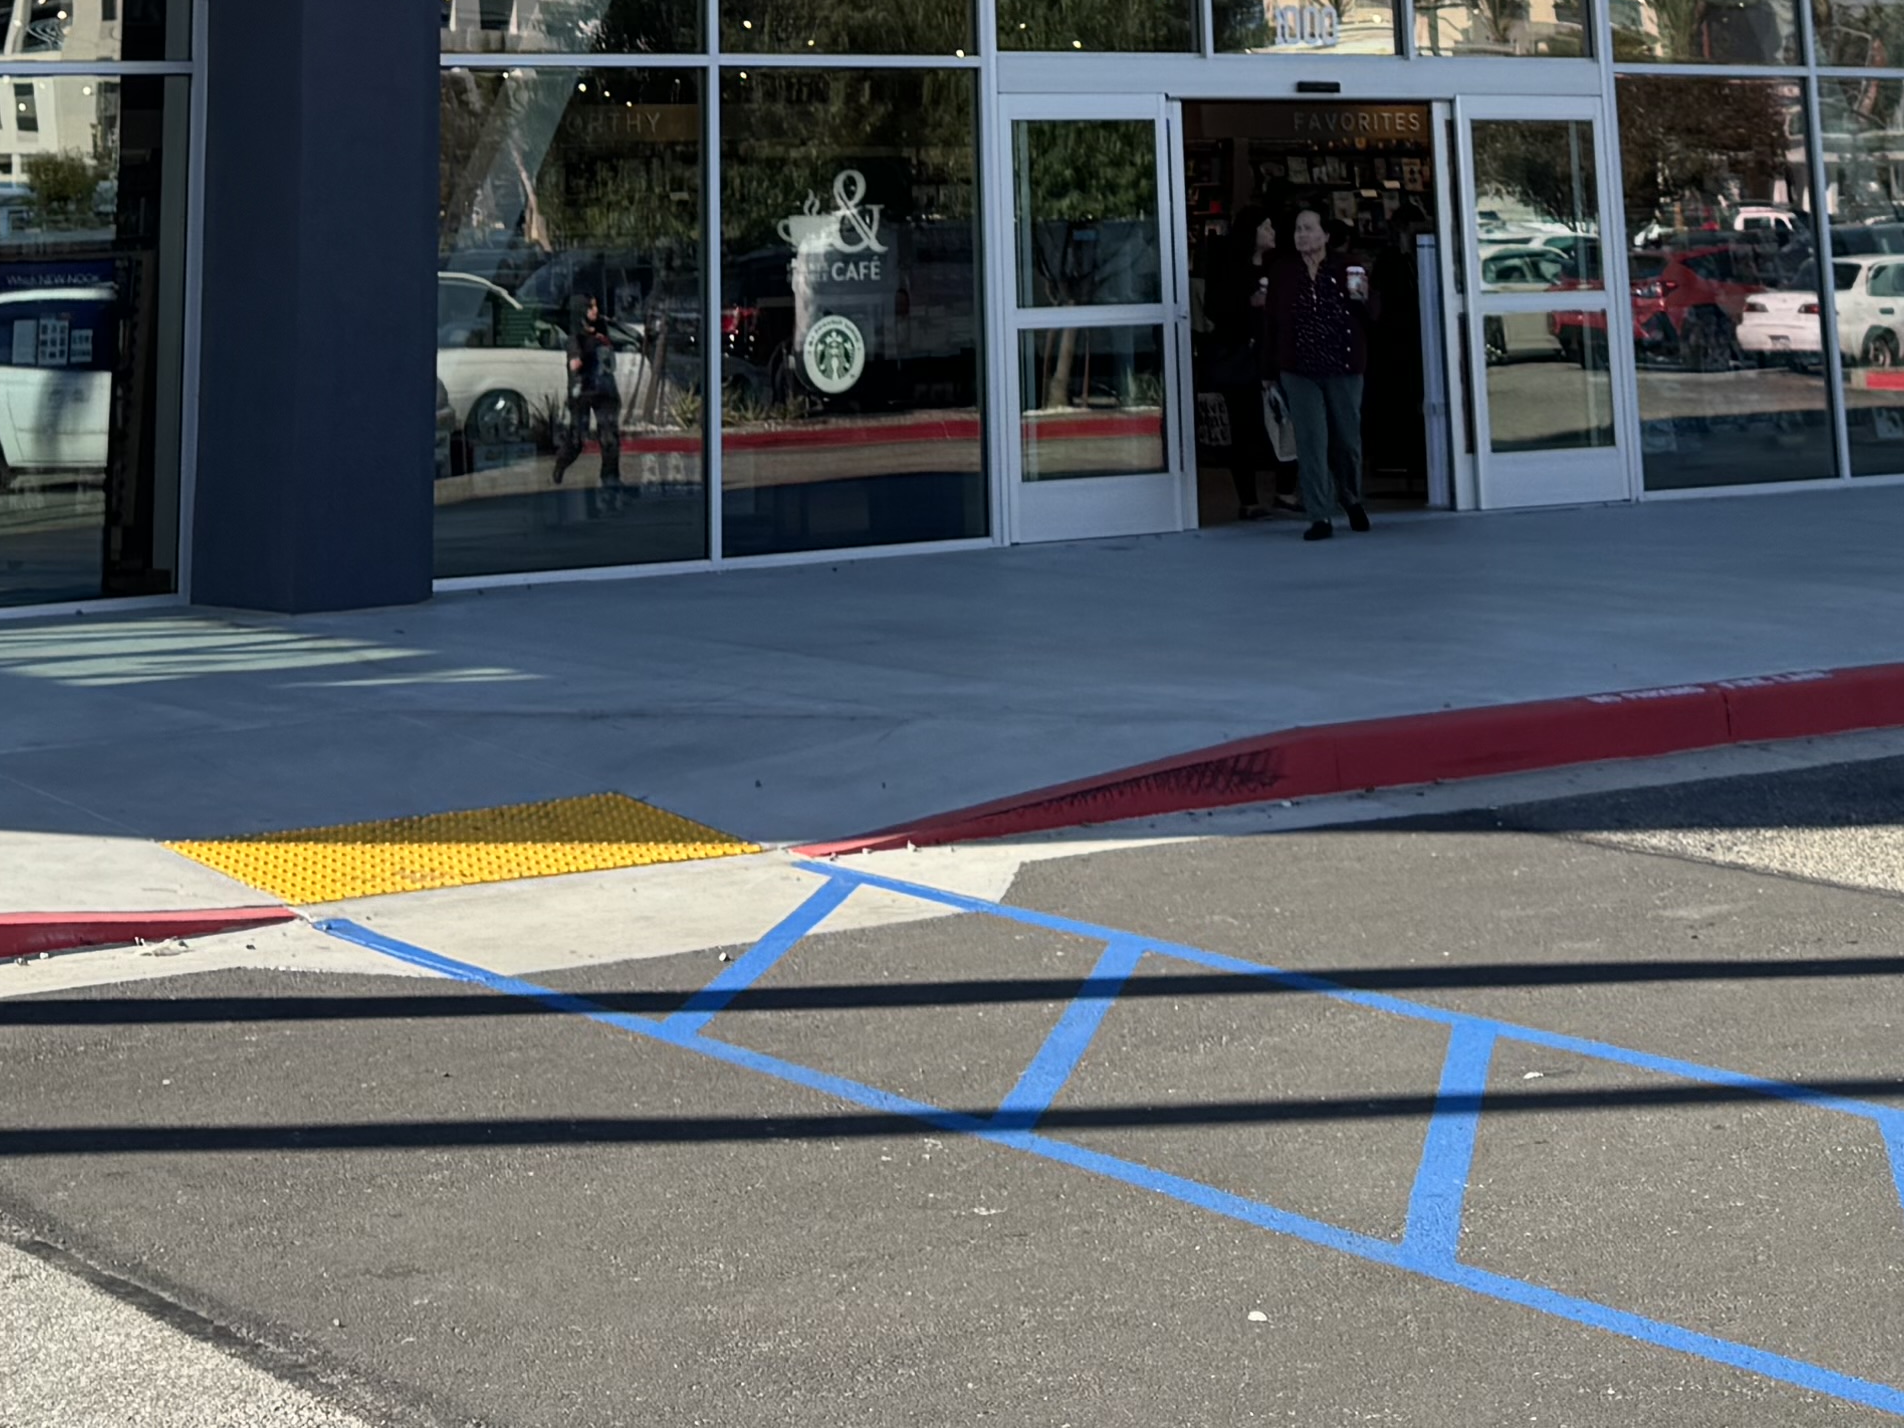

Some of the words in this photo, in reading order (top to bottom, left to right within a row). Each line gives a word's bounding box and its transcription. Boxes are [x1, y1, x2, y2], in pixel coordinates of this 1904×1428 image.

[1274, 5, 1338, 47] 1000
[1293, 111, 1422, 133] FAVORITES
[831, 255, 881, 282] CAFÉ
